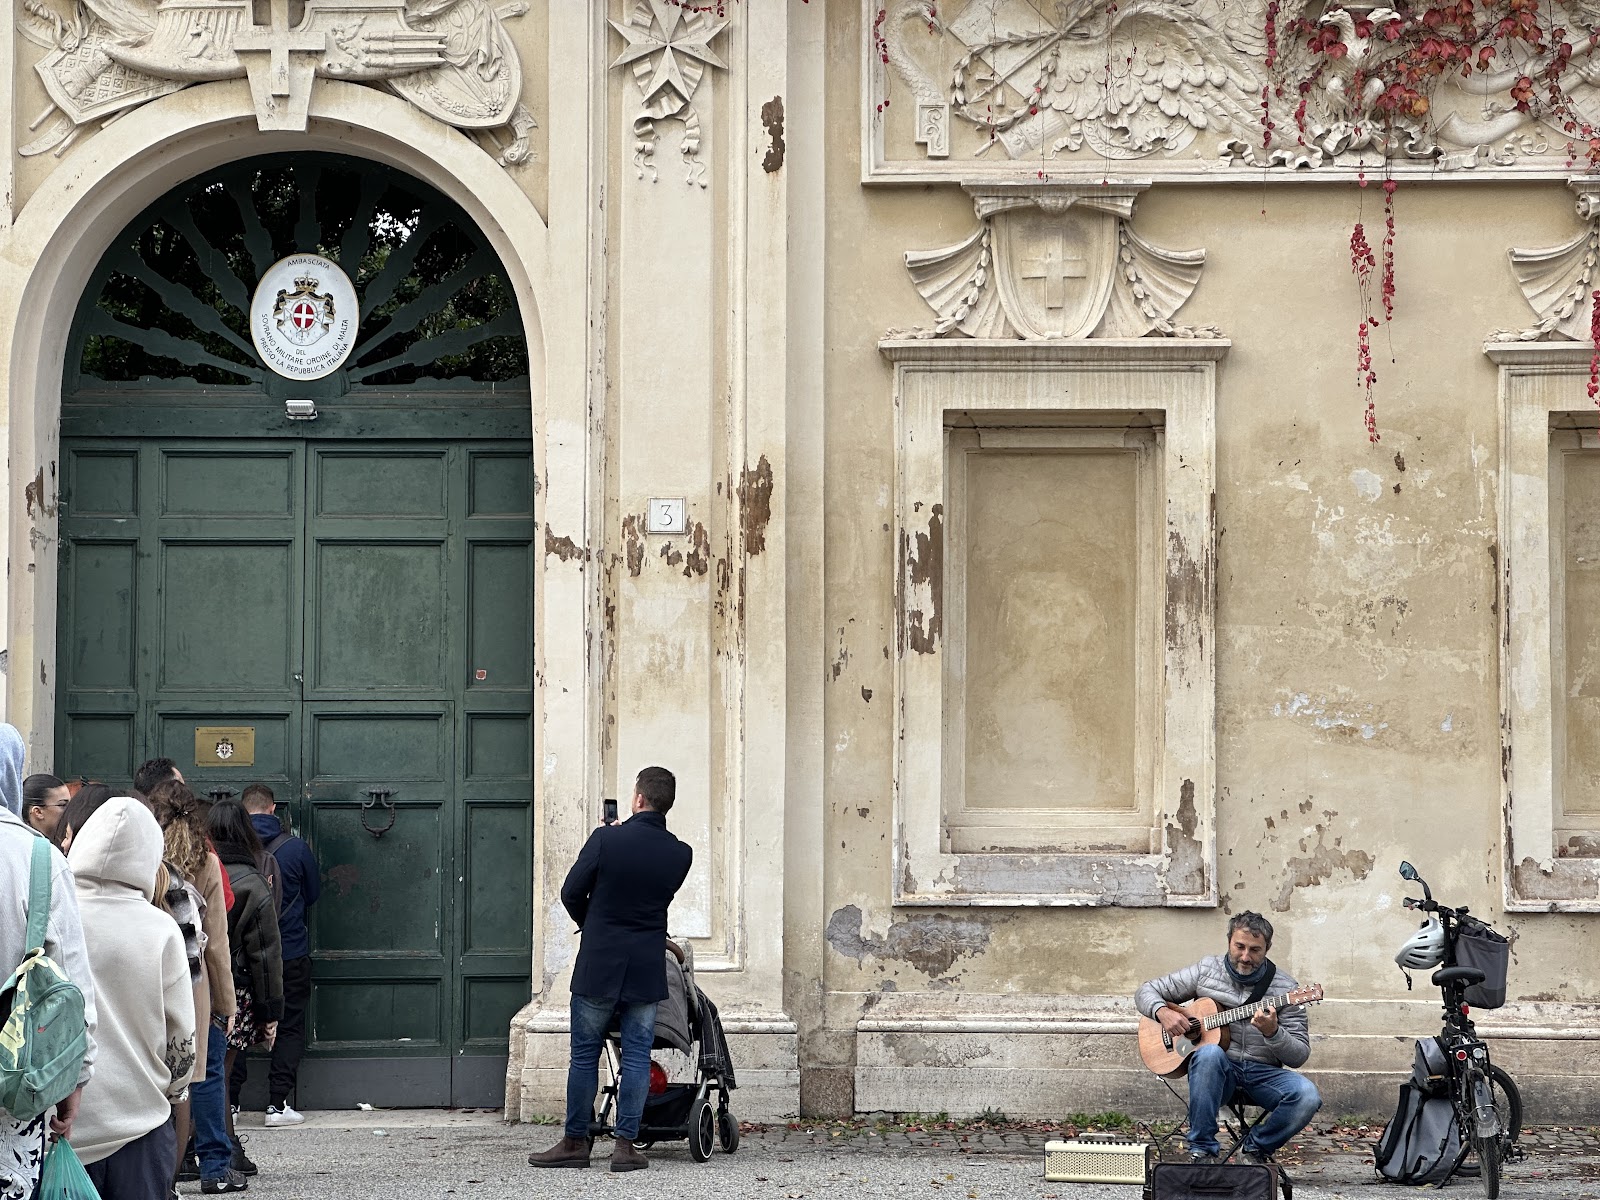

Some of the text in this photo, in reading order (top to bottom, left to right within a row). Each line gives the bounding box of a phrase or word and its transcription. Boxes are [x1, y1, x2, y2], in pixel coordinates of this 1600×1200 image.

[288, 258, 330, 270] AMBASCIATA
[262, 314, 276, 346] SOVRANO
[275, 346, 304, 365] MILITARE
[306, 350, 332, 366] ORDINE
[338, 320, 348, 342] MALTA
[260, 338, 348, 374] PRESSO LA REPUBBLICA ITALIANA
[660, 504, 672, 526] 3
